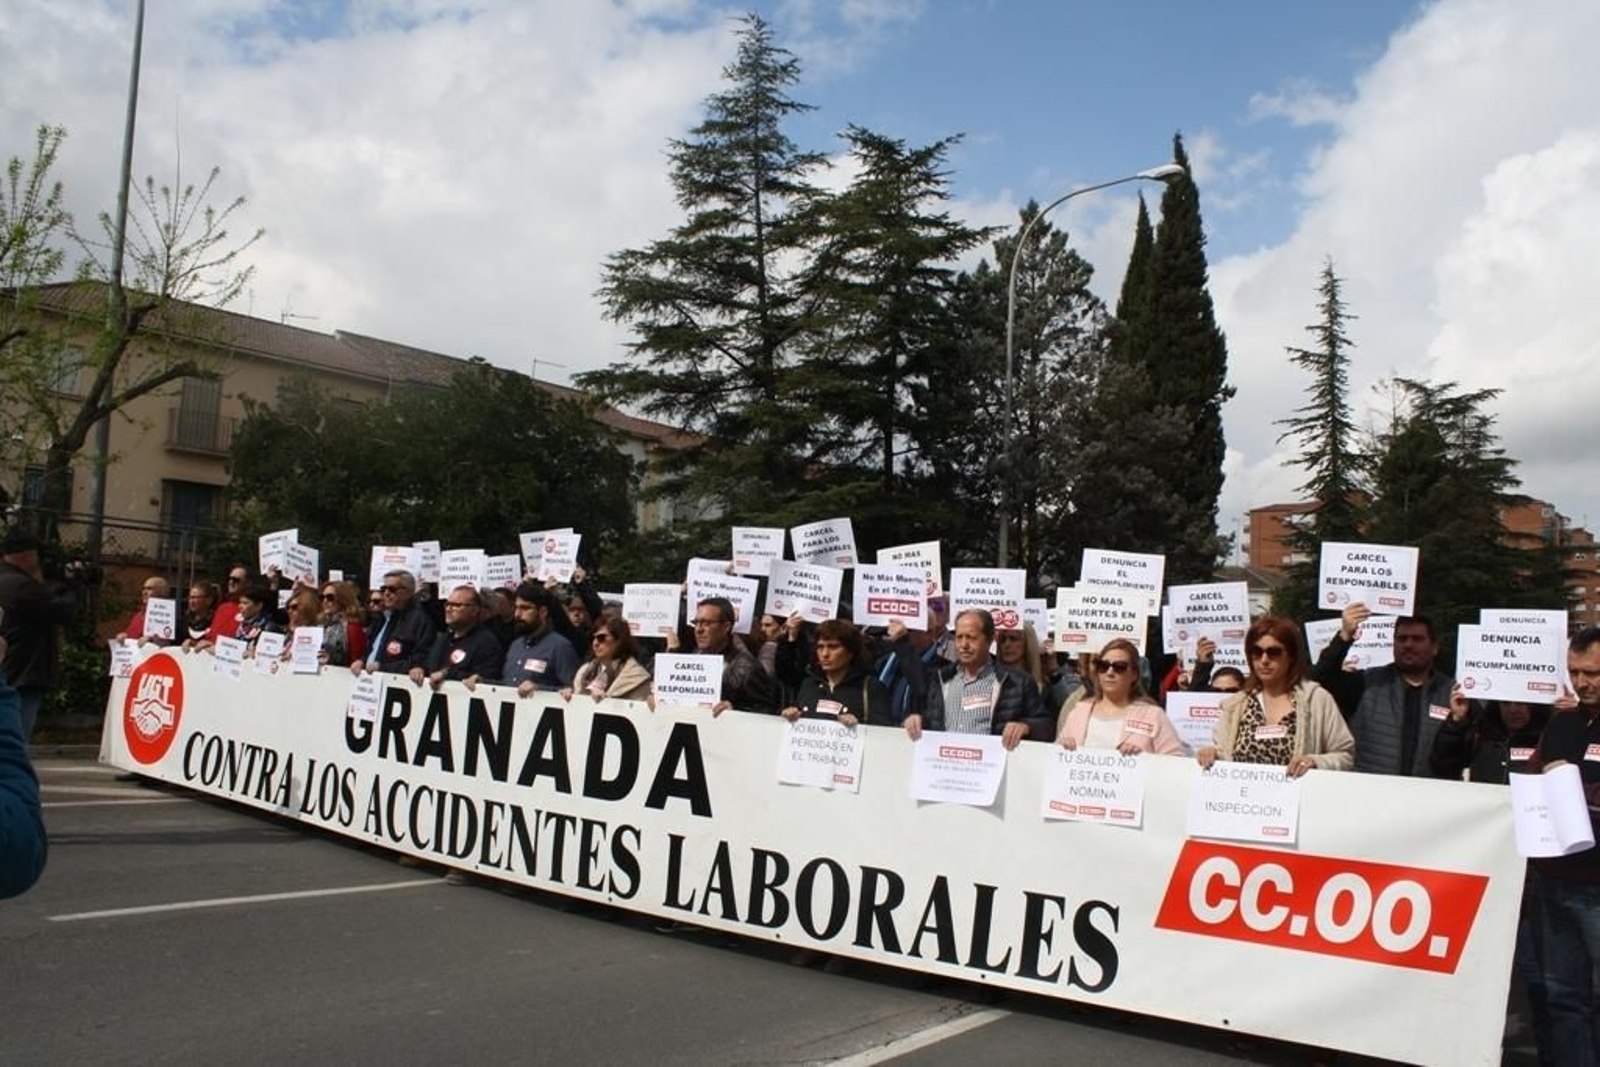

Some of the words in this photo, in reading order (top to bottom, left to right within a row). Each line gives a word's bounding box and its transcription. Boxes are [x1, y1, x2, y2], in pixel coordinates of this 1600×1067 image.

[804, 526, 834, 539] CARCEL
[824, 534, 840, 545] LOS
[1100, 556, 1148, 568] DENUNCIA
[1346, 552, 1388, 564] CARCEL
[863, 573, 875, 581] No
[1117, 570, 1129, 578] EL
[1340, 565, 1369, 575] PARA
[1371, 566, 1393, 577] LOS
[788, 580, 806, 589] PARA
[808, 583, 823, 592] LOS
[969, 576, 1001, 585] CARCEL
[1087, 578, 1156, 592] INCUMPLIMIENTO
[1325, 577, 1408, 591] RESPONSABLES
[868, 585, 880, 593] En
[965, 587, 988, 596] PARA
[989, 588, 1006, 596] LOS
[954, 598, 1018, 608] RESPONSABLES
[1082, 596, 1099, 605] NO
[1101, 597, 1123, 606] MAS
[1188, 592, 1224, 602] CARCEL
[1068, 608, 1117, 619] MUERTES
[1120, 610, 1137, 620] EN
[1186, 604, 1209, 613] PARA
[1211, 603, 1229, 612] LOS
[1174, 615, 1244, 625] RESPONSABLES
[1499, 616, 1547, 625] DENUNCIA
[1067, 621, 1082, 630] EL
[1084, 622, 1134, 633] TRABAJO
[1376, 632, 1388, 640] EL
[1480, 633, 1541, 646] DENUNCIA
[1224, 648, 1240, 656] LOS
[1503, 649, 1517, 659] EL
[674, 661, 705, 672] CARCEL
[1464, 660, 1556, 674] INCUMPLIMIENTO
[669, 673, 692, 683] PARA
[693, 674, 707, 683] LOS
[137, 672, 175, 704] UGT
[657, 684, 717, 696] RESPONSABLES
[793, 723, 806, 733] NO
[807, 724, 827, 735] MAS
[829, 725, 858, 741] VIDAS
[345, 685, 713, 818] GRANADA
[791, 738, 838, 751] PERDIDAS
[840, 742, 854, 753] EN
[792, 751, 804, 762] EL
[808, 752, 849, 767] TRABAJO
[1058, 752, 1073, 763] TU
[1076, 754, 1114, 768] SALUD
[1116, 756, 1137, 769] NO
[1070, 769, 1101, 783] ESTA
[1103, 772, 1120, 784] EN
[1230, 769, 1293, 784] CONTROL
[1069, 786, 1117, 800] NOMINA
[1240, 786, 1248, 798] E
[1205, 801, 1282, 818] INSPECCION
[183, 730, 293, 808] CONTRA
[300, 758, 357, 827] LOS
[363, 774, 642, 900] ACCIDENTES
[662, 833, 1120, 993] LABORALES
[1188, 855, 1450, 958] CC.OO.
